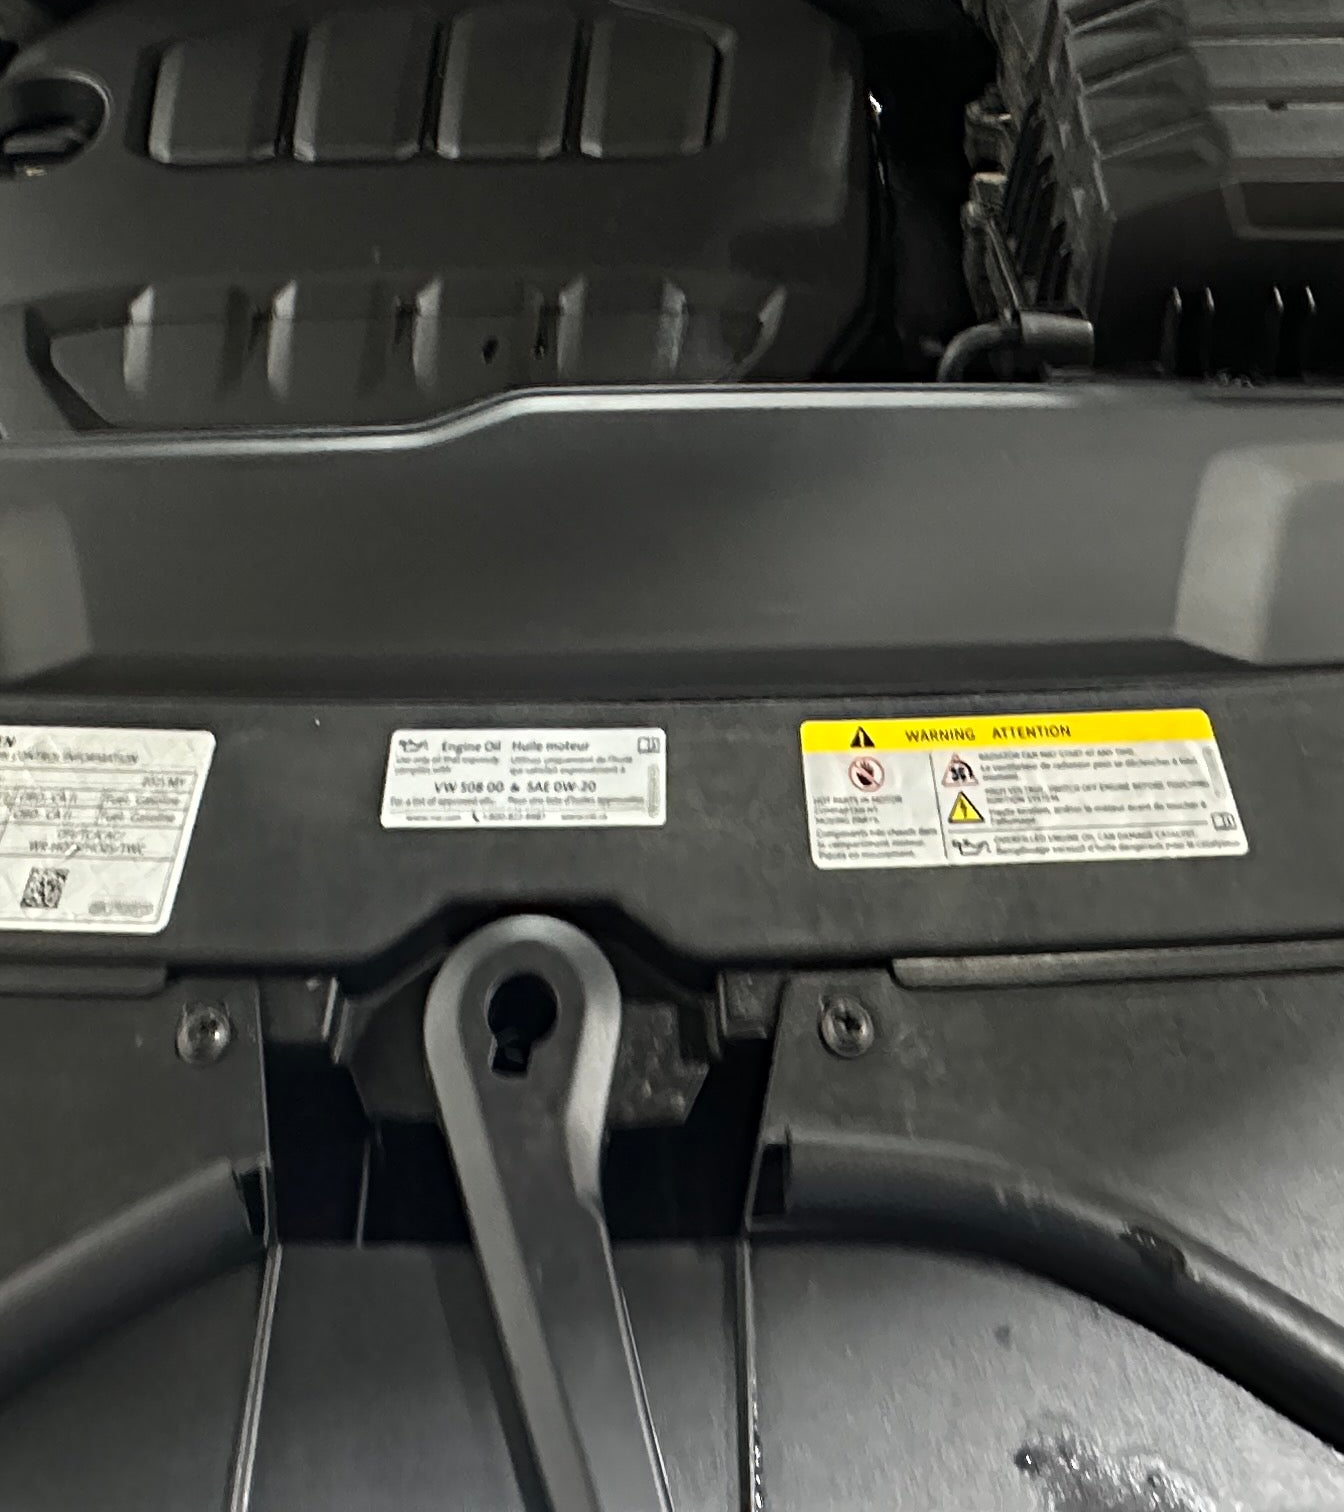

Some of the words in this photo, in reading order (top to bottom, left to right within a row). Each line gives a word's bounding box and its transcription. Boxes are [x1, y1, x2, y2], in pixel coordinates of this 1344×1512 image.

[905, 728, 976, 743] WARNING
[992, 725, 1072, 739] ATTENTION
[441, 739, 481, 754] Engine
[484, 740, 501, 752] Oil
[511, 740, 543, 751] Huile
[546, 741, 590, 751] moteur
[434, 781, 458, 793] VW
[460, 781, 484, 793] 508
[487, 781, 505, 793] 00
[510, 782, 520, 793] &
[527, 781, 549, 793] SAE
